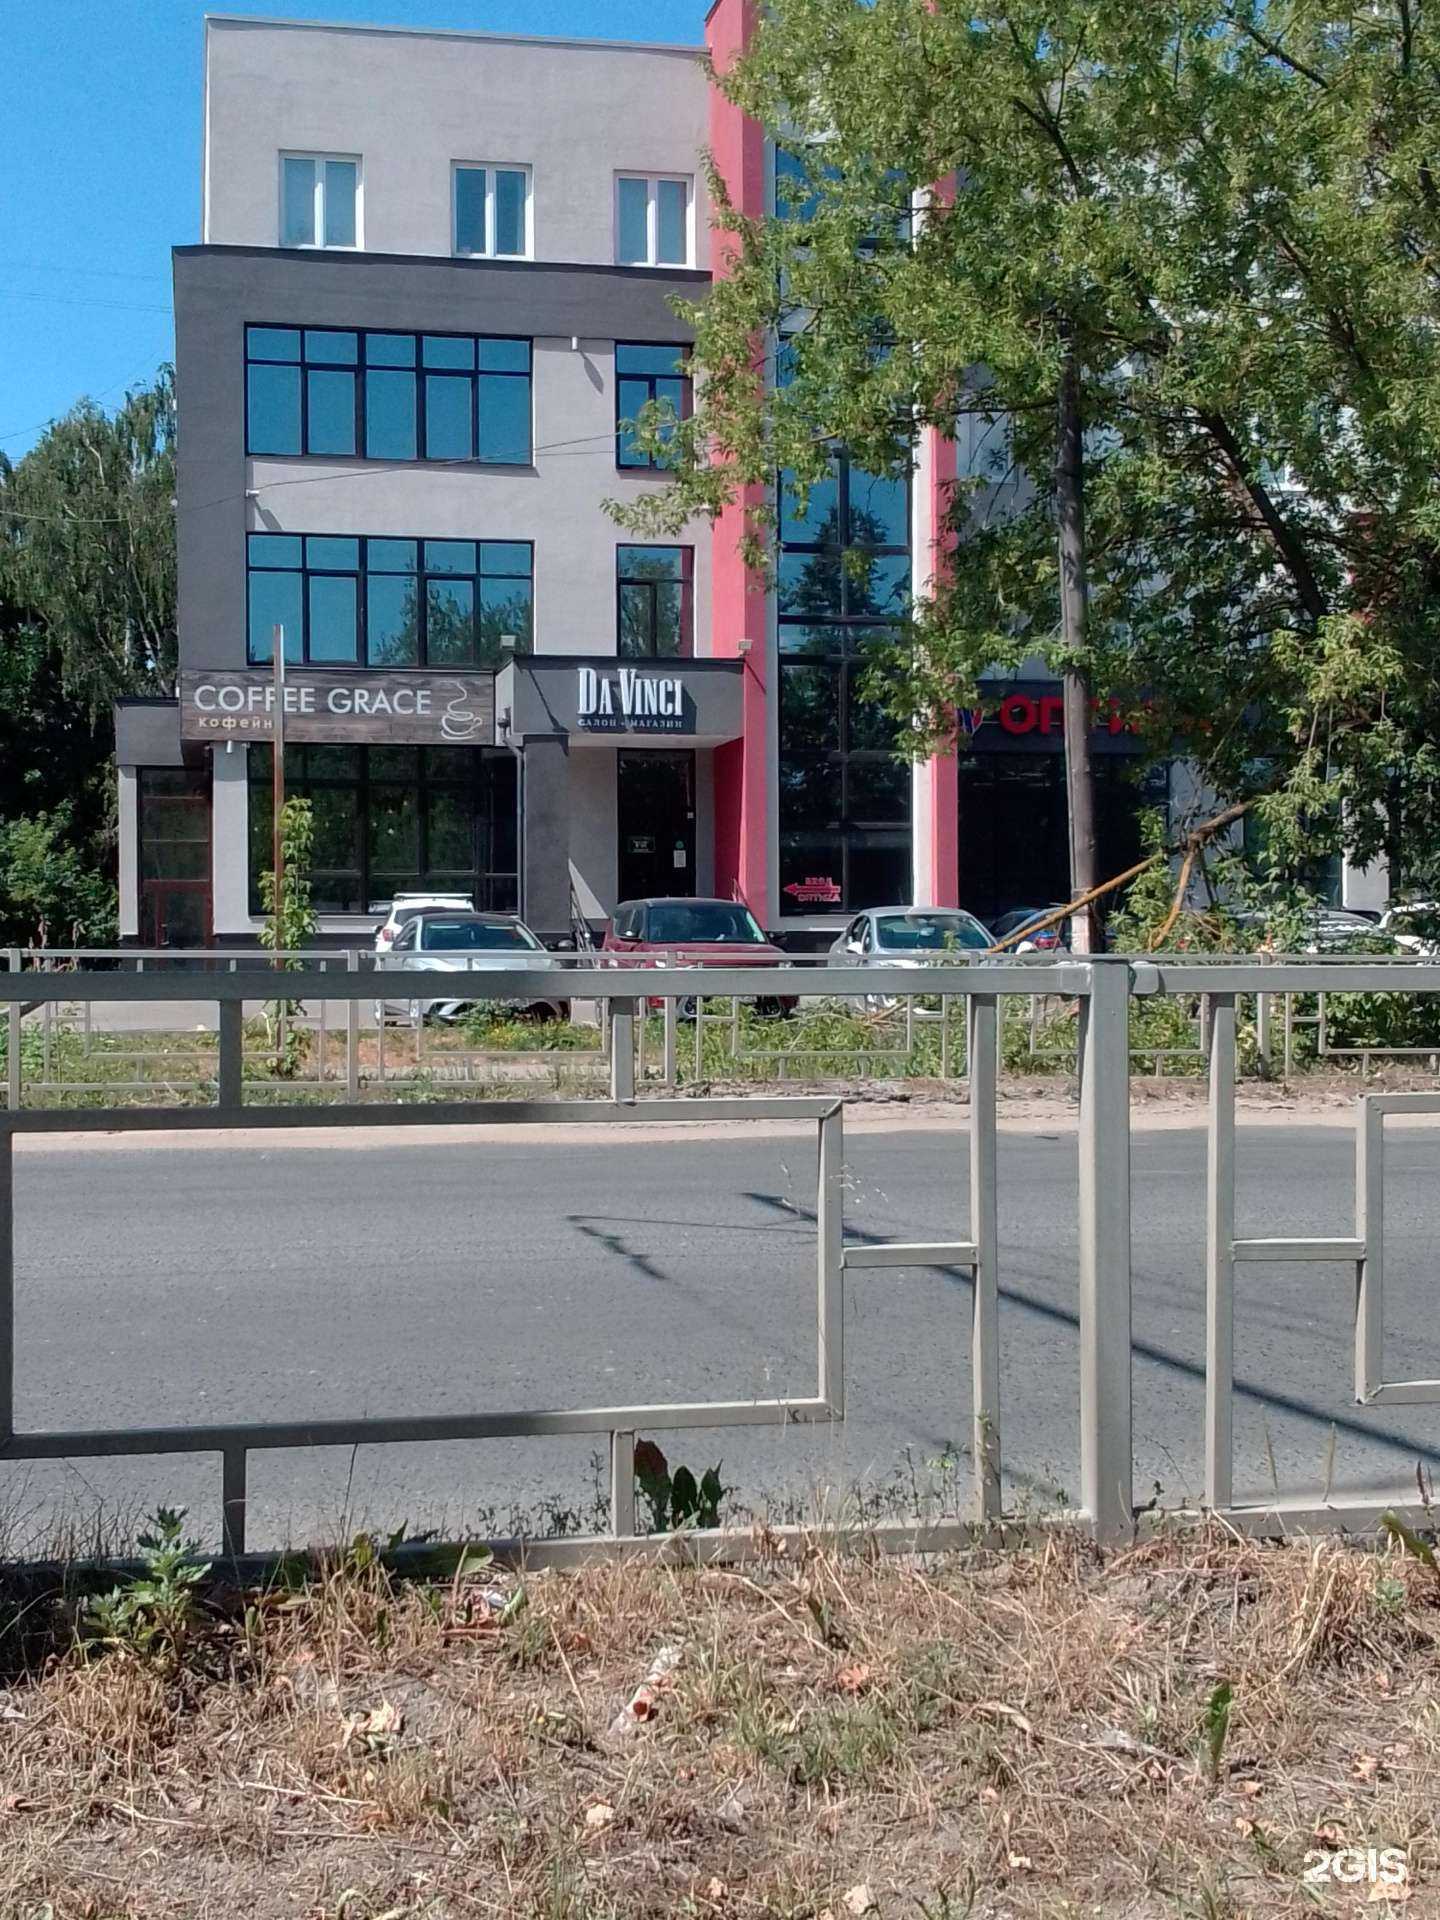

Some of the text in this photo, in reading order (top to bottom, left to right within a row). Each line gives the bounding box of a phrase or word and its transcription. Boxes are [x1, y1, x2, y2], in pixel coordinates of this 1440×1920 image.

[194, 685, 431, 715] COFFEE GRACE
[198, 715, 274, 731] Кофейн
